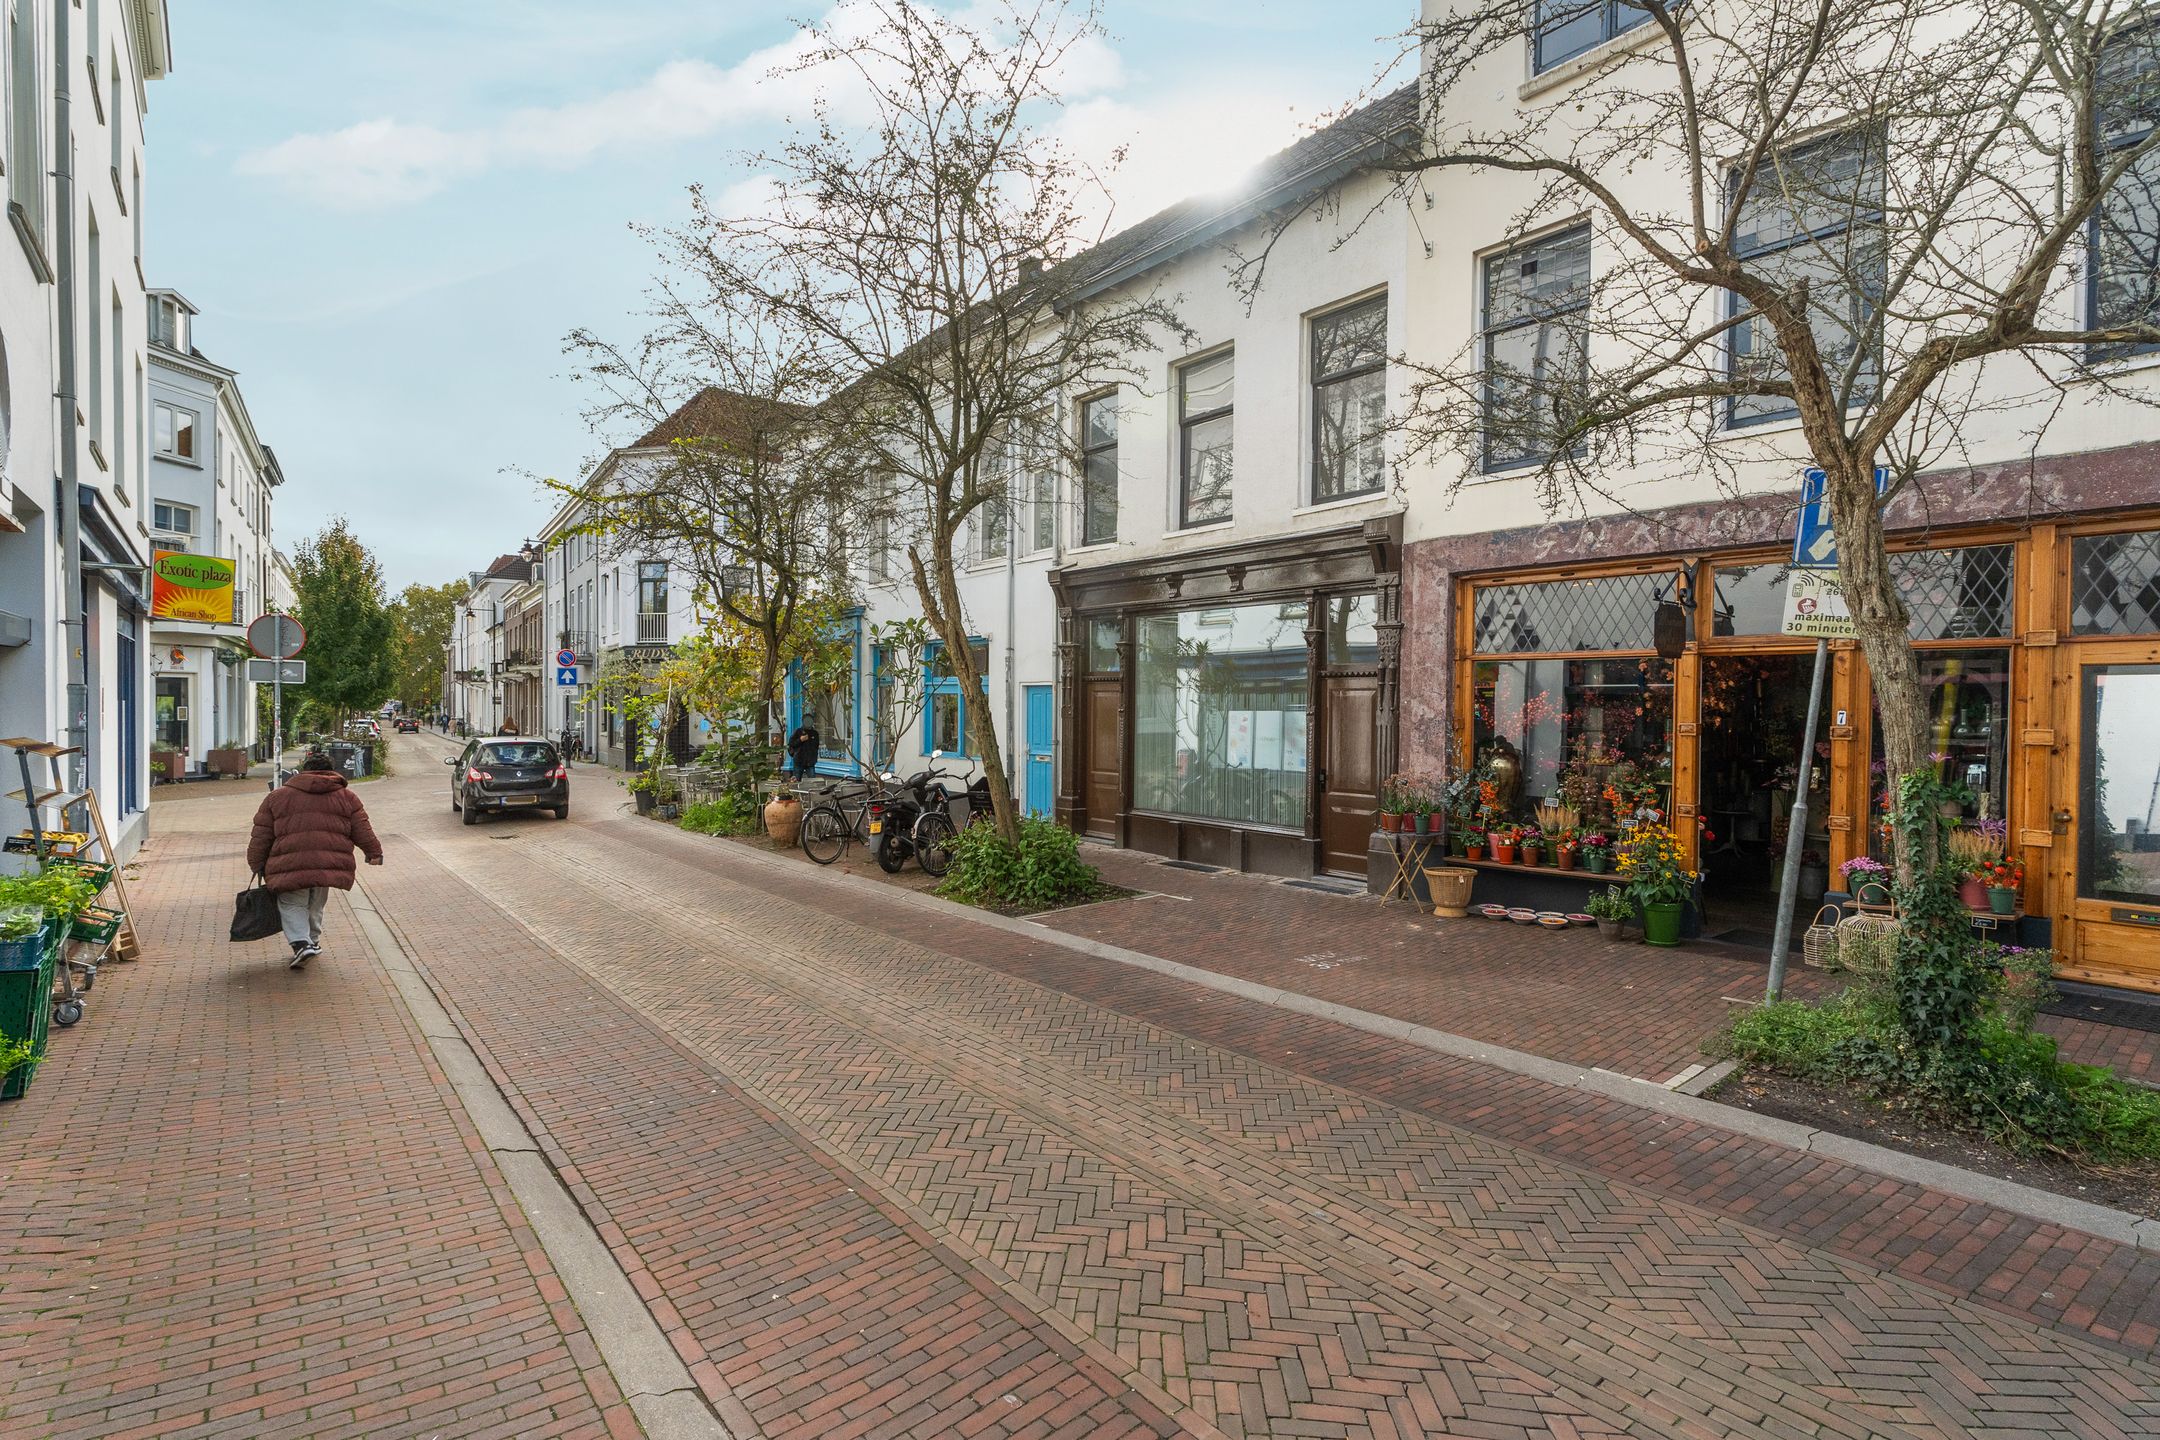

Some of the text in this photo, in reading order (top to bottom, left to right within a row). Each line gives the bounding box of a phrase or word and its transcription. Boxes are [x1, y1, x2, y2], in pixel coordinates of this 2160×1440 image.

[159, 560, 232, 583] Exotic plaza
[1826, 588, 1842, 596] 26
[170, 608, 217, 622] African Shop
[1794, 613, 1852, 624] maximaa
[1786, 622, 1803, 632] 30
[1838, 712, 1845, 723] 7
